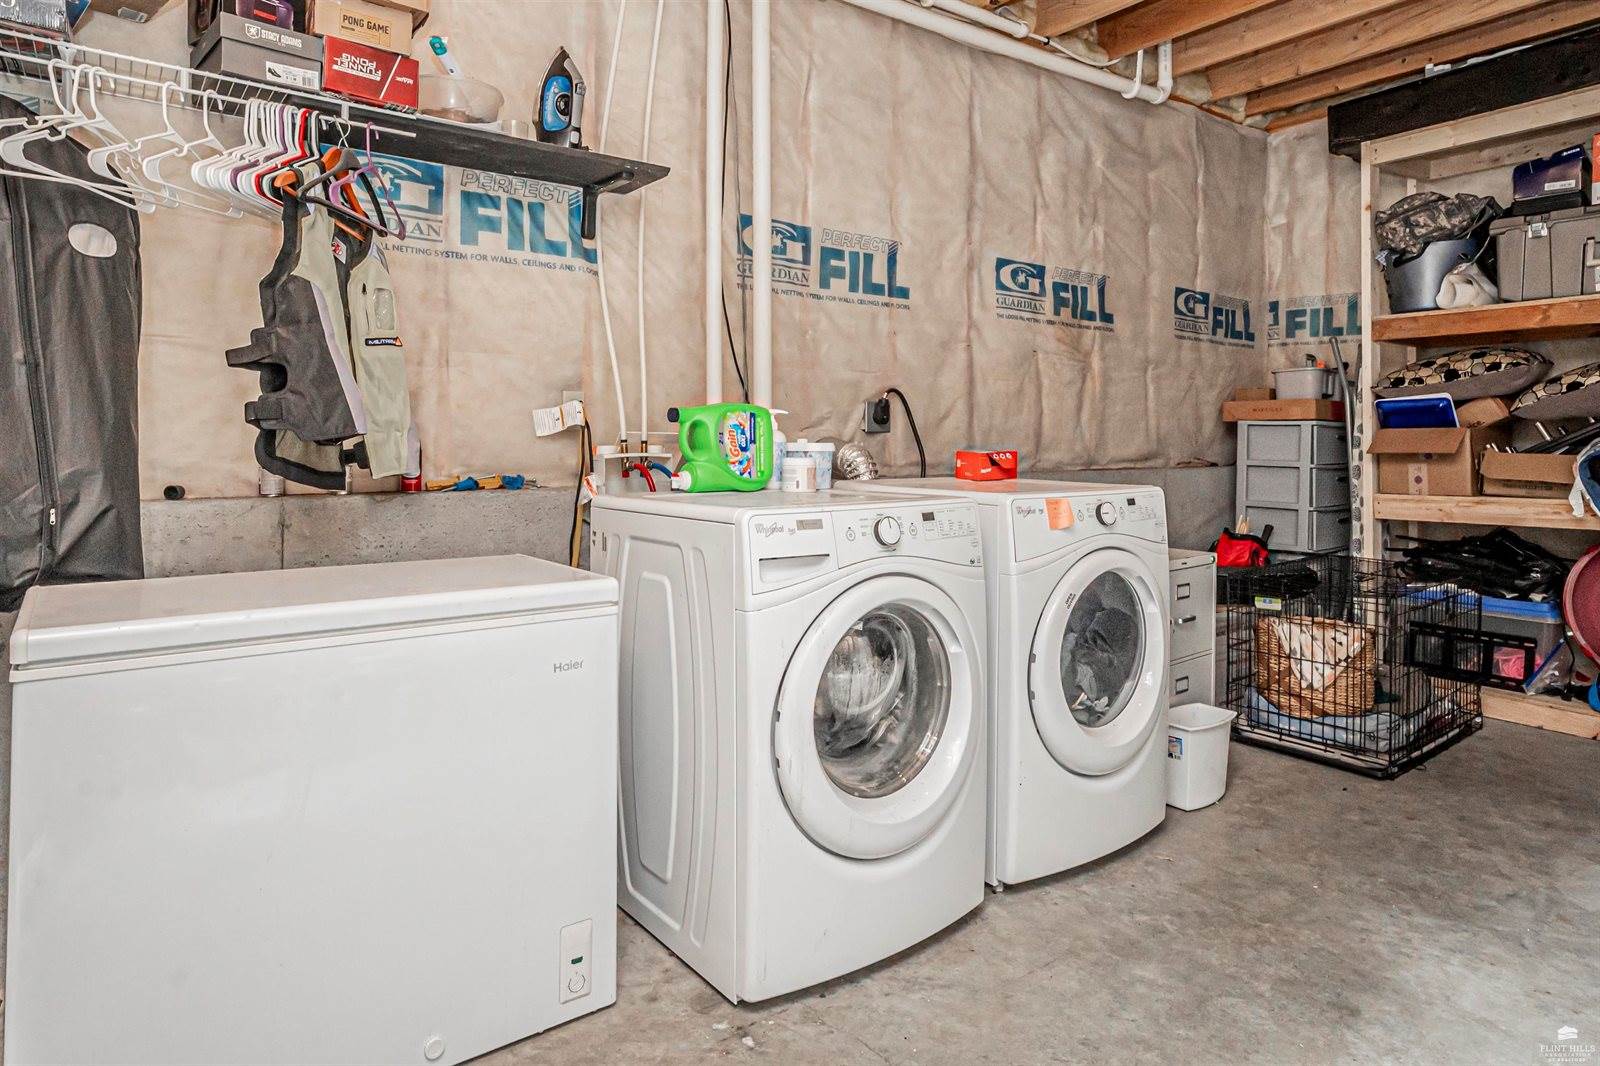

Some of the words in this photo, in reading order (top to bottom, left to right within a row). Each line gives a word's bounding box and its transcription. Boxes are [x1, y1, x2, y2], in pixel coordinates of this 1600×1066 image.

[261, 29, 280, 42] STACY
[281, 34, 303, 48] ADAMS
[341, 14, 364, 28] PONG
[366, 21, 390, 35] GAME
[333, 57, 382, 78] FUNNEL
[341, 52, 377, 69] PONG
[460, 168, 570, 204] PERFECT
[460, 189, 598, 265] FILL
[821, 227, 890, 253] PERFECT
[392, 243, 432, 257] NETTING
[434, 249, 468, 261] SYSTEM
[470, 252, 488, 262] FOR
[521, 257, 557, 270] CEILINGS
[559, 262, 576, 272] AND
[819, 240, 911, 300] FILL
[997, 296, 1045, 312] GUARDIAN
[1051, 274, 1114, 324] FILL
[1212, 300, 1255, 341] FILL
[1285, 292, 1362, 339] FILL
[727, 429, 741, 458] Gain
[553, 659, 584, 673] Haier
